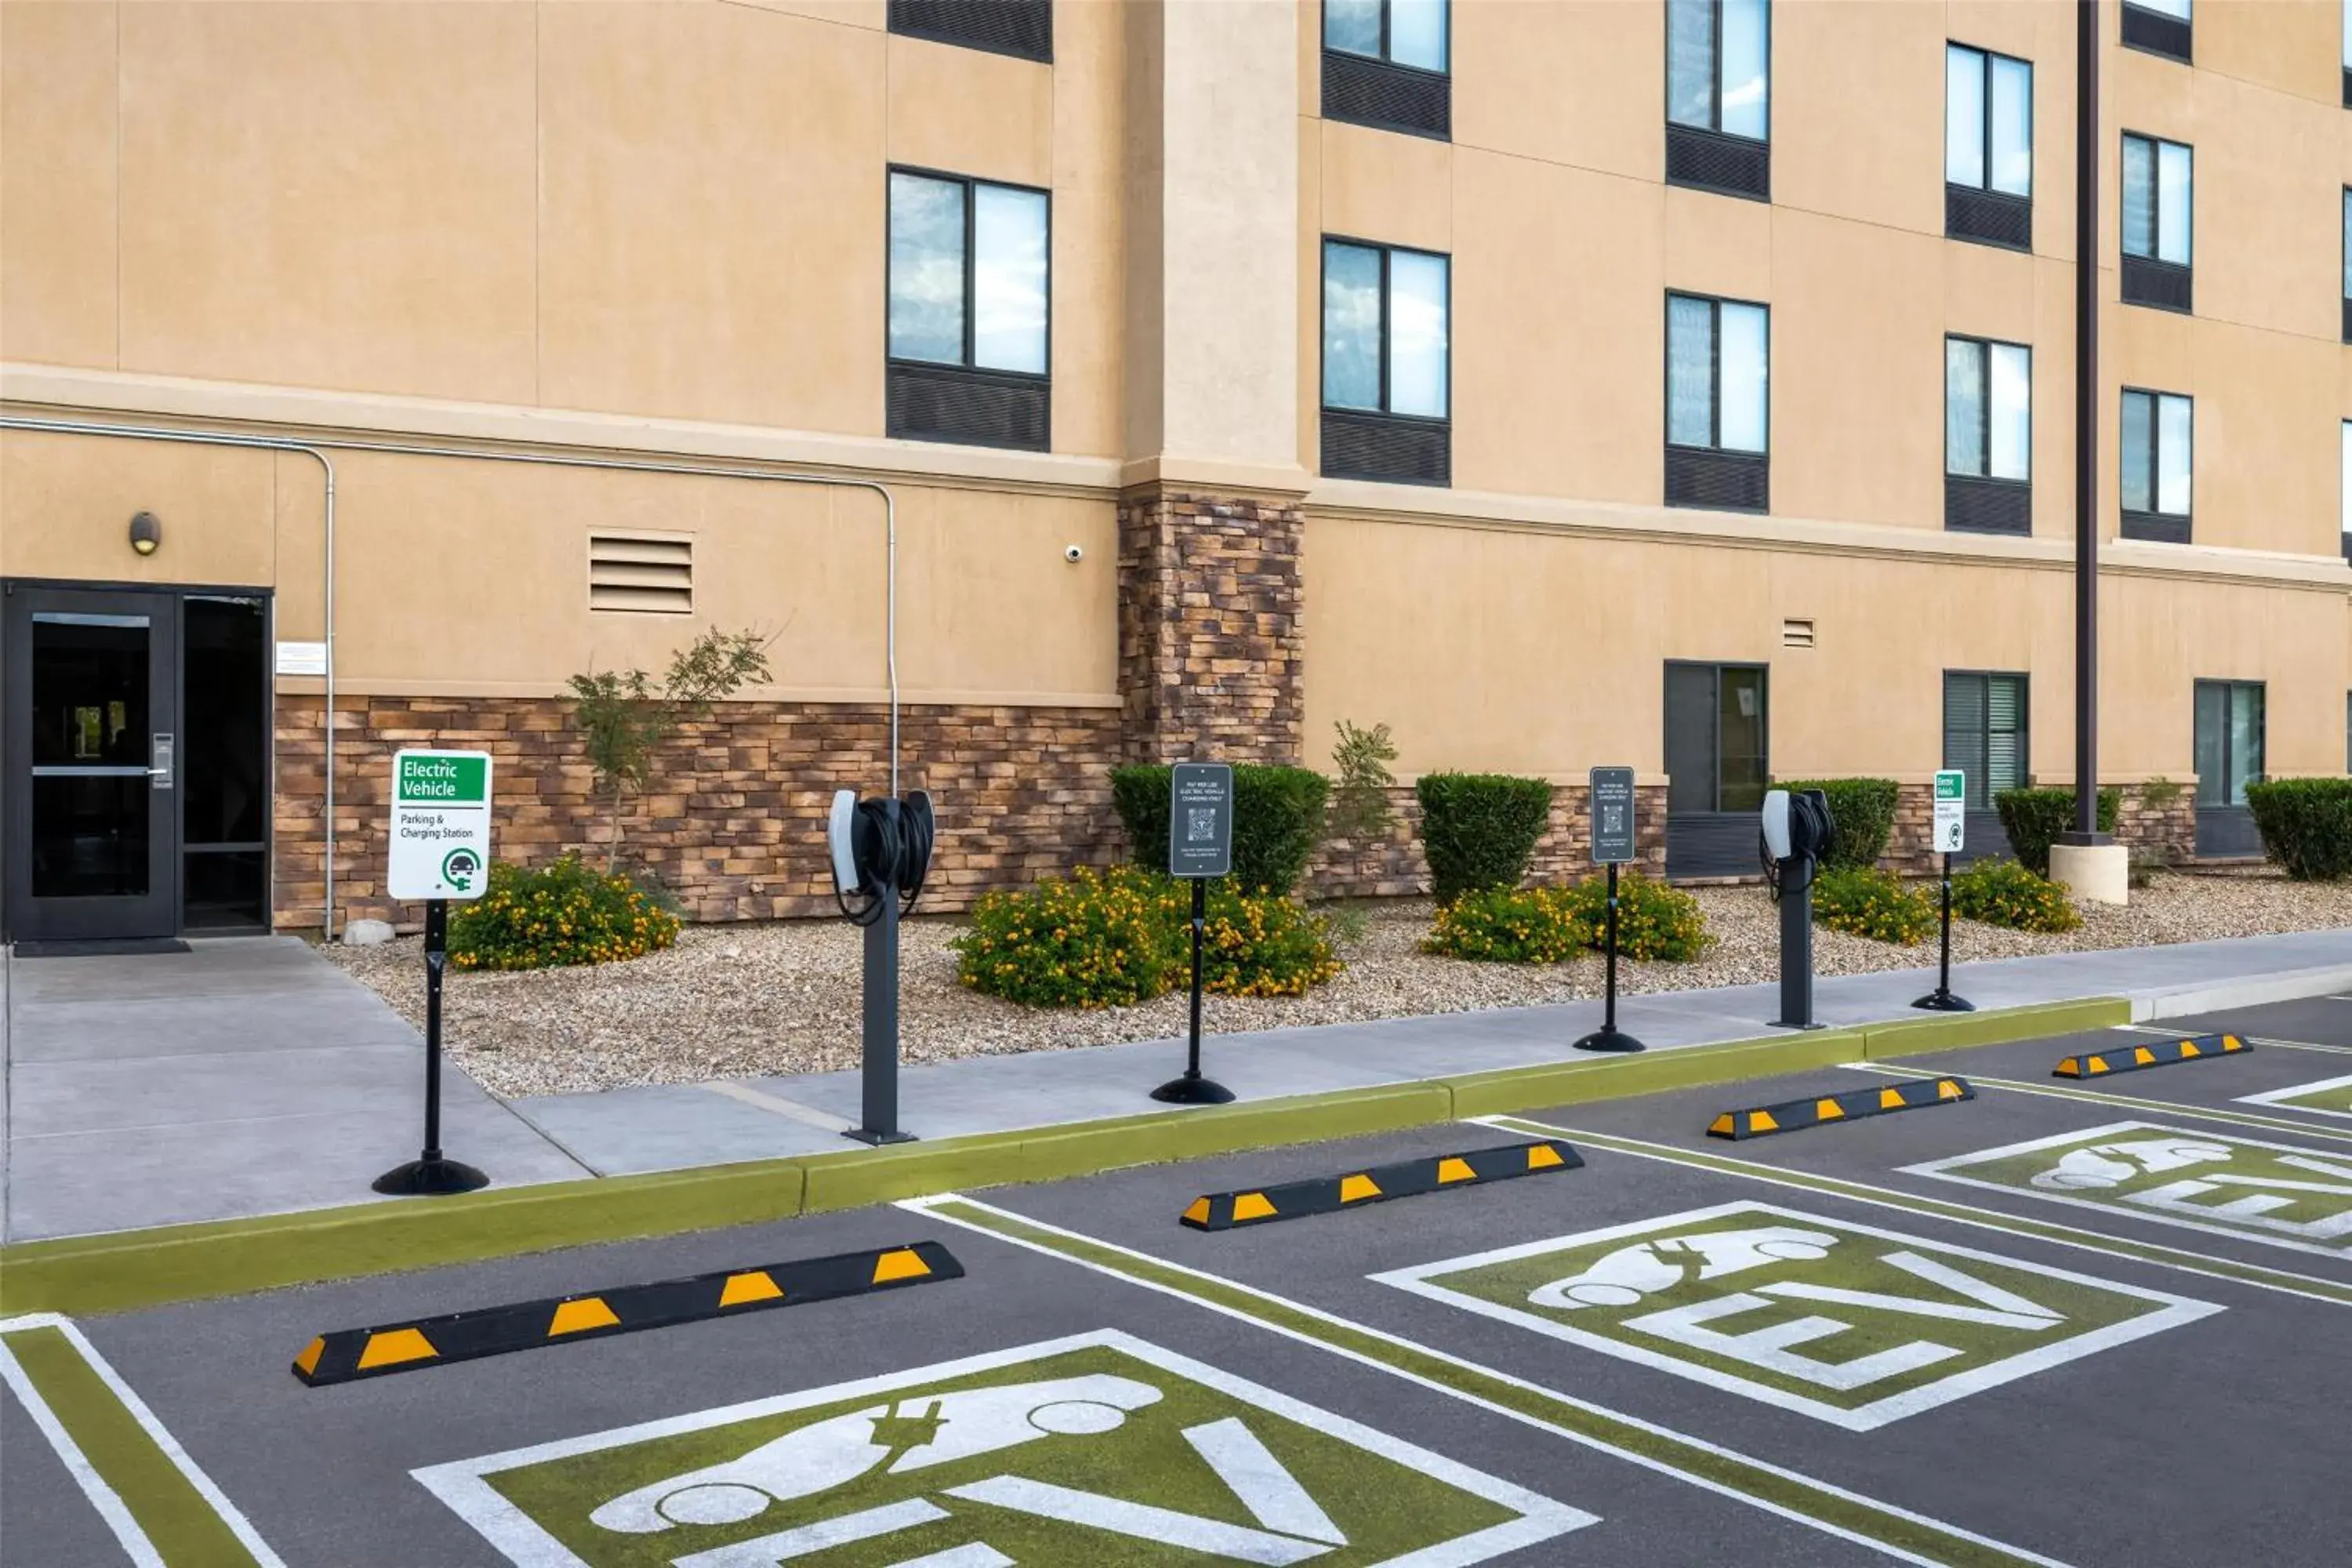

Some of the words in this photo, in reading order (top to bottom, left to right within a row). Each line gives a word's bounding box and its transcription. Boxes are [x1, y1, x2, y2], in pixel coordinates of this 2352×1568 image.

[404, 760, 458, 779] Electric
[404, 780, 456, 797] Vehicle
[401, 814, 435, 826] Parking
[437, 815, 445, 825] &
[401, 828, 441, 840] Charging
[443, 828, 474, 839] Station
[1618, 1250, 2070, 1392] EV
